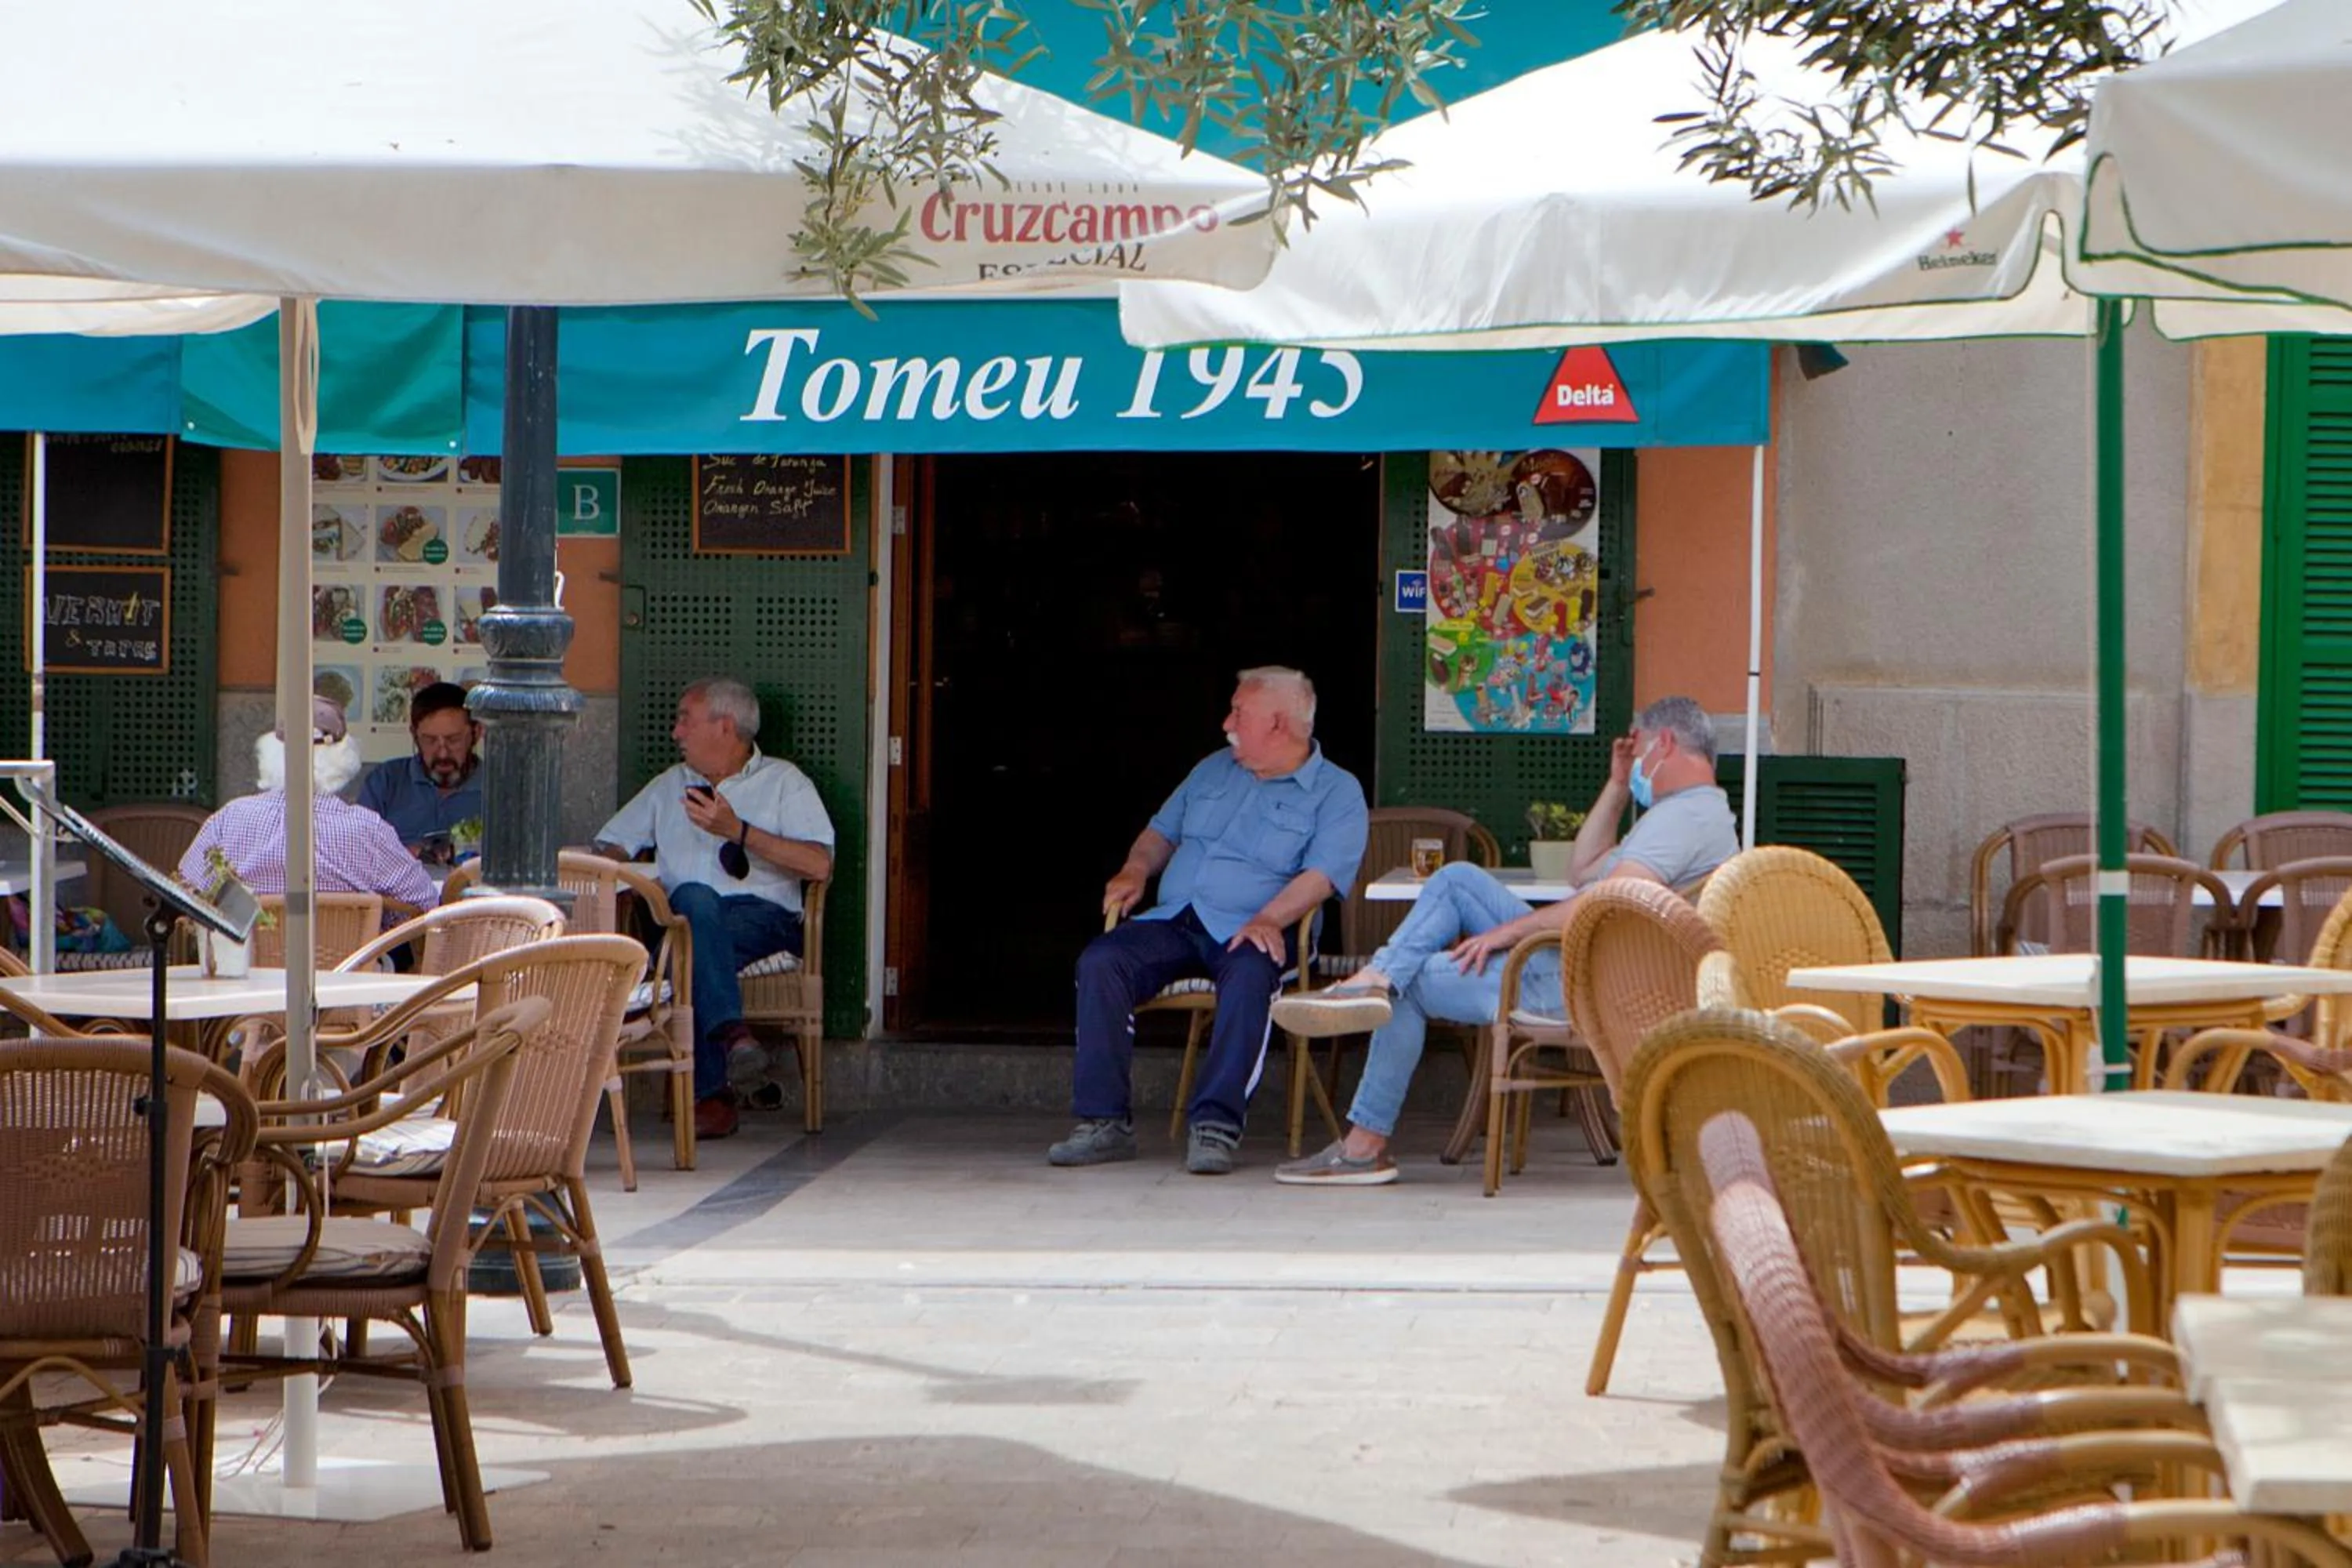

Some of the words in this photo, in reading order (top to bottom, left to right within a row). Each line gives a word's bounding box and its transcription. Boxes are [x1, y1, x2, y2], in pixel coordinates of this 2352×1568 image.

[920, 191, 1218, 244] Cruzcampo
[740, 328, 1083, 423] Tomeu
[1116, 346, 1363, 420] 1945
[1557, 383, 1614, 406] Delta
[574, 485, 601, 520] B
